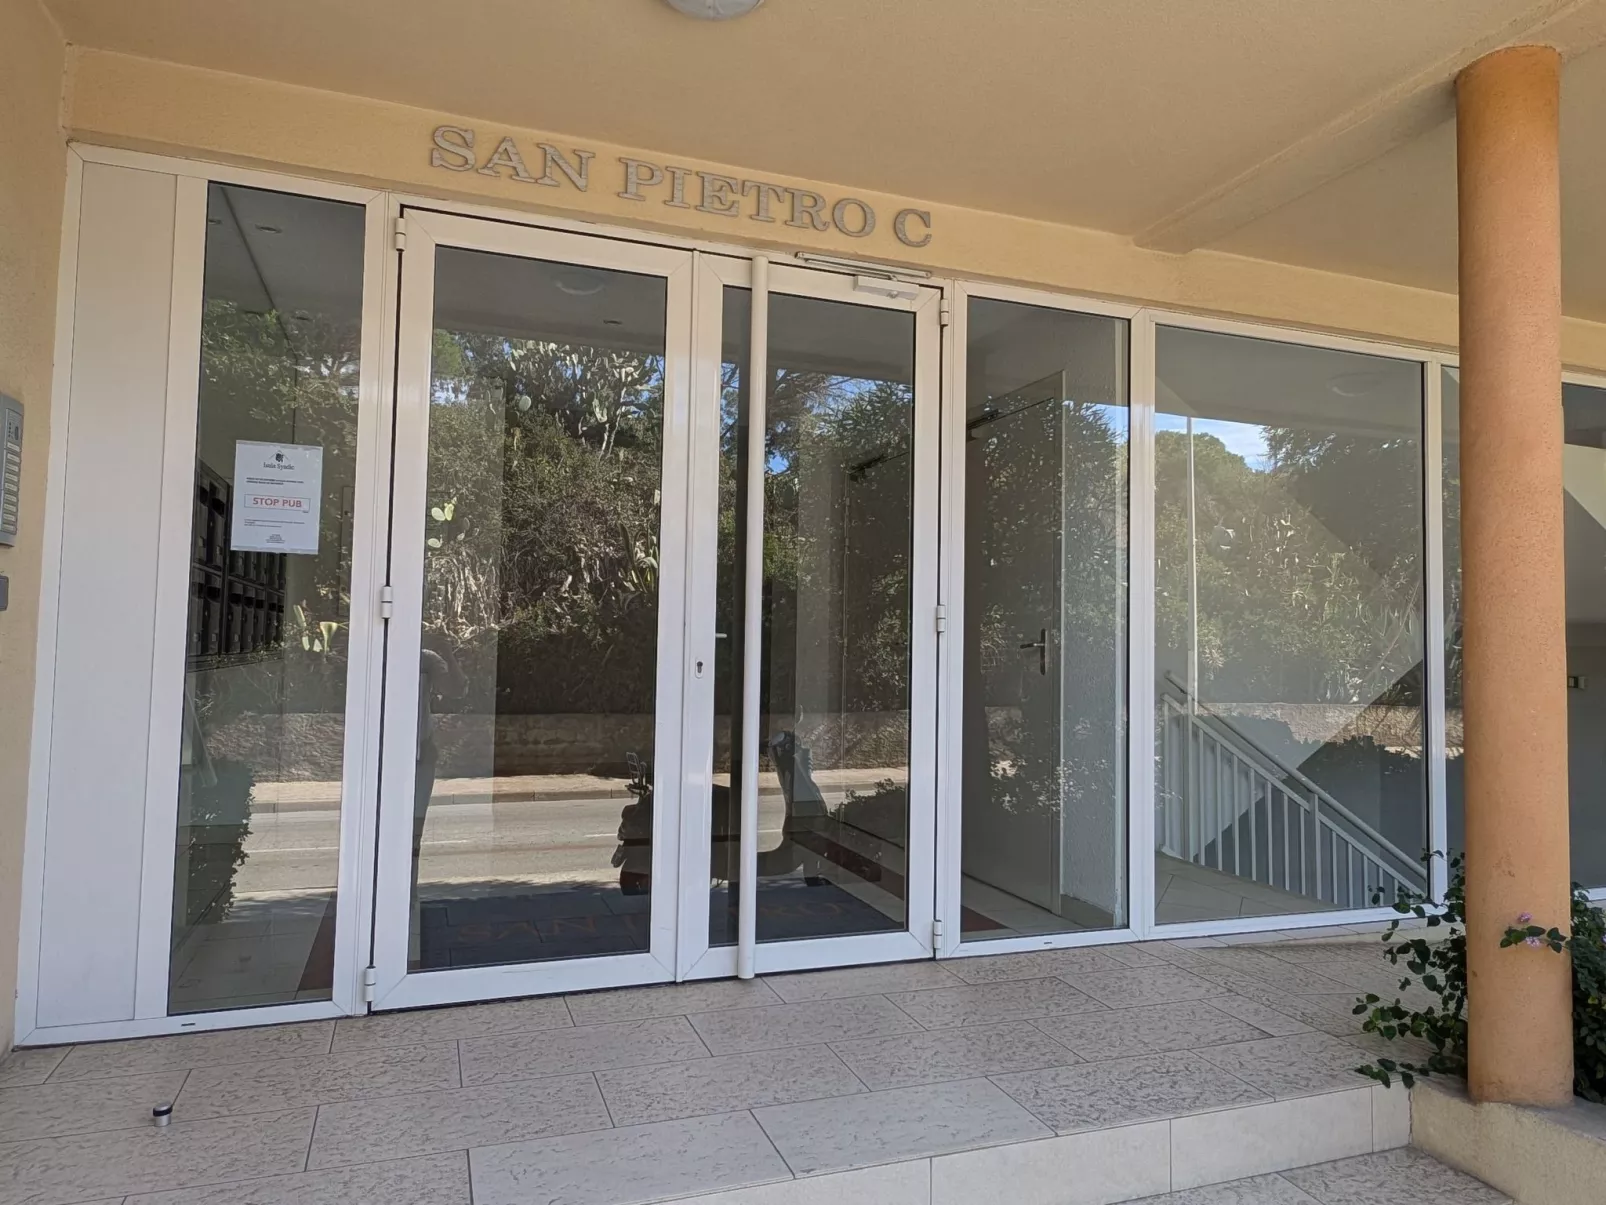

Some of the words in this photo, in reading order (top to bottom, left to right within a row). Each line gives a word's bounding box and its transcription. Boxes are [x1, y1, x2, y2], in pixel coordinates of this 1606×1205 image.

[430, 125, 596, 192] SAN
[617, 156, 876, 237] PIETRO
[893, 208, 932, 248] C
[252, 497, 279, 506] STOP
[282, 499, 302, 508] PUB
[457, 915, 599, 942] SAN
